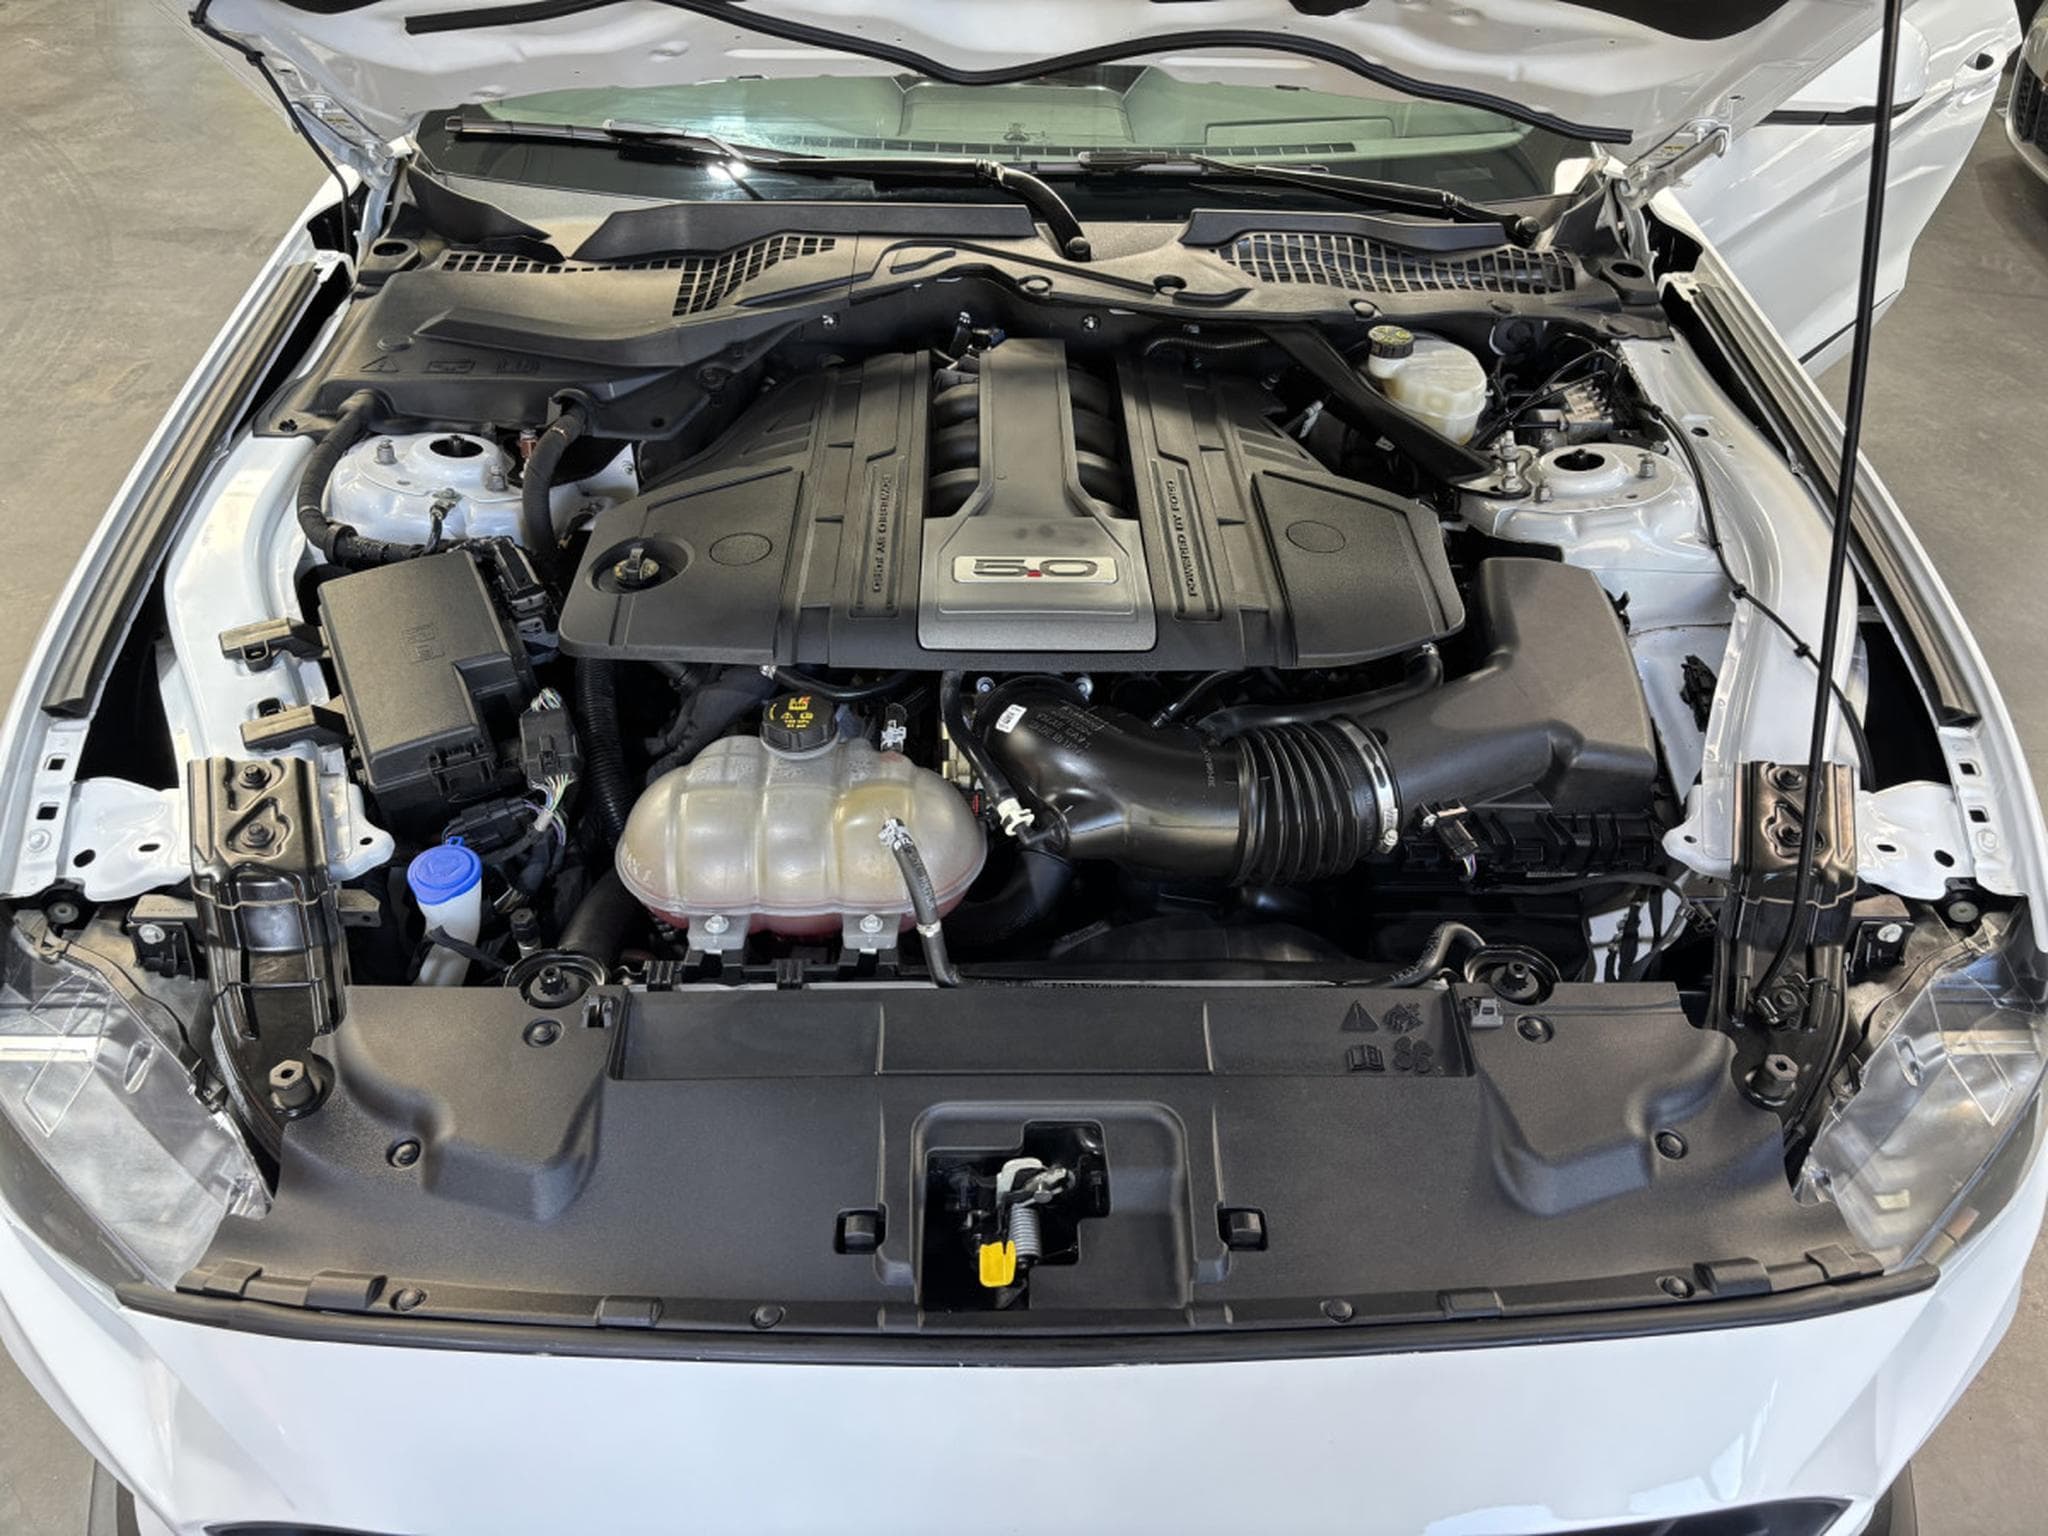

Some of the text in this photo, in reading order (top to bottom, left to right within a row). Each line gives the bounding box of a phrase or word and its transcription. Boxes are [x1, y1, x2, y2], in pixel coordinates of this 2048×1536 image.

[1166, 480, 1180, 512] FORD
[972, 558, 1099, 577] 5.0
[1177, 534, 1198, 597] POWERED
